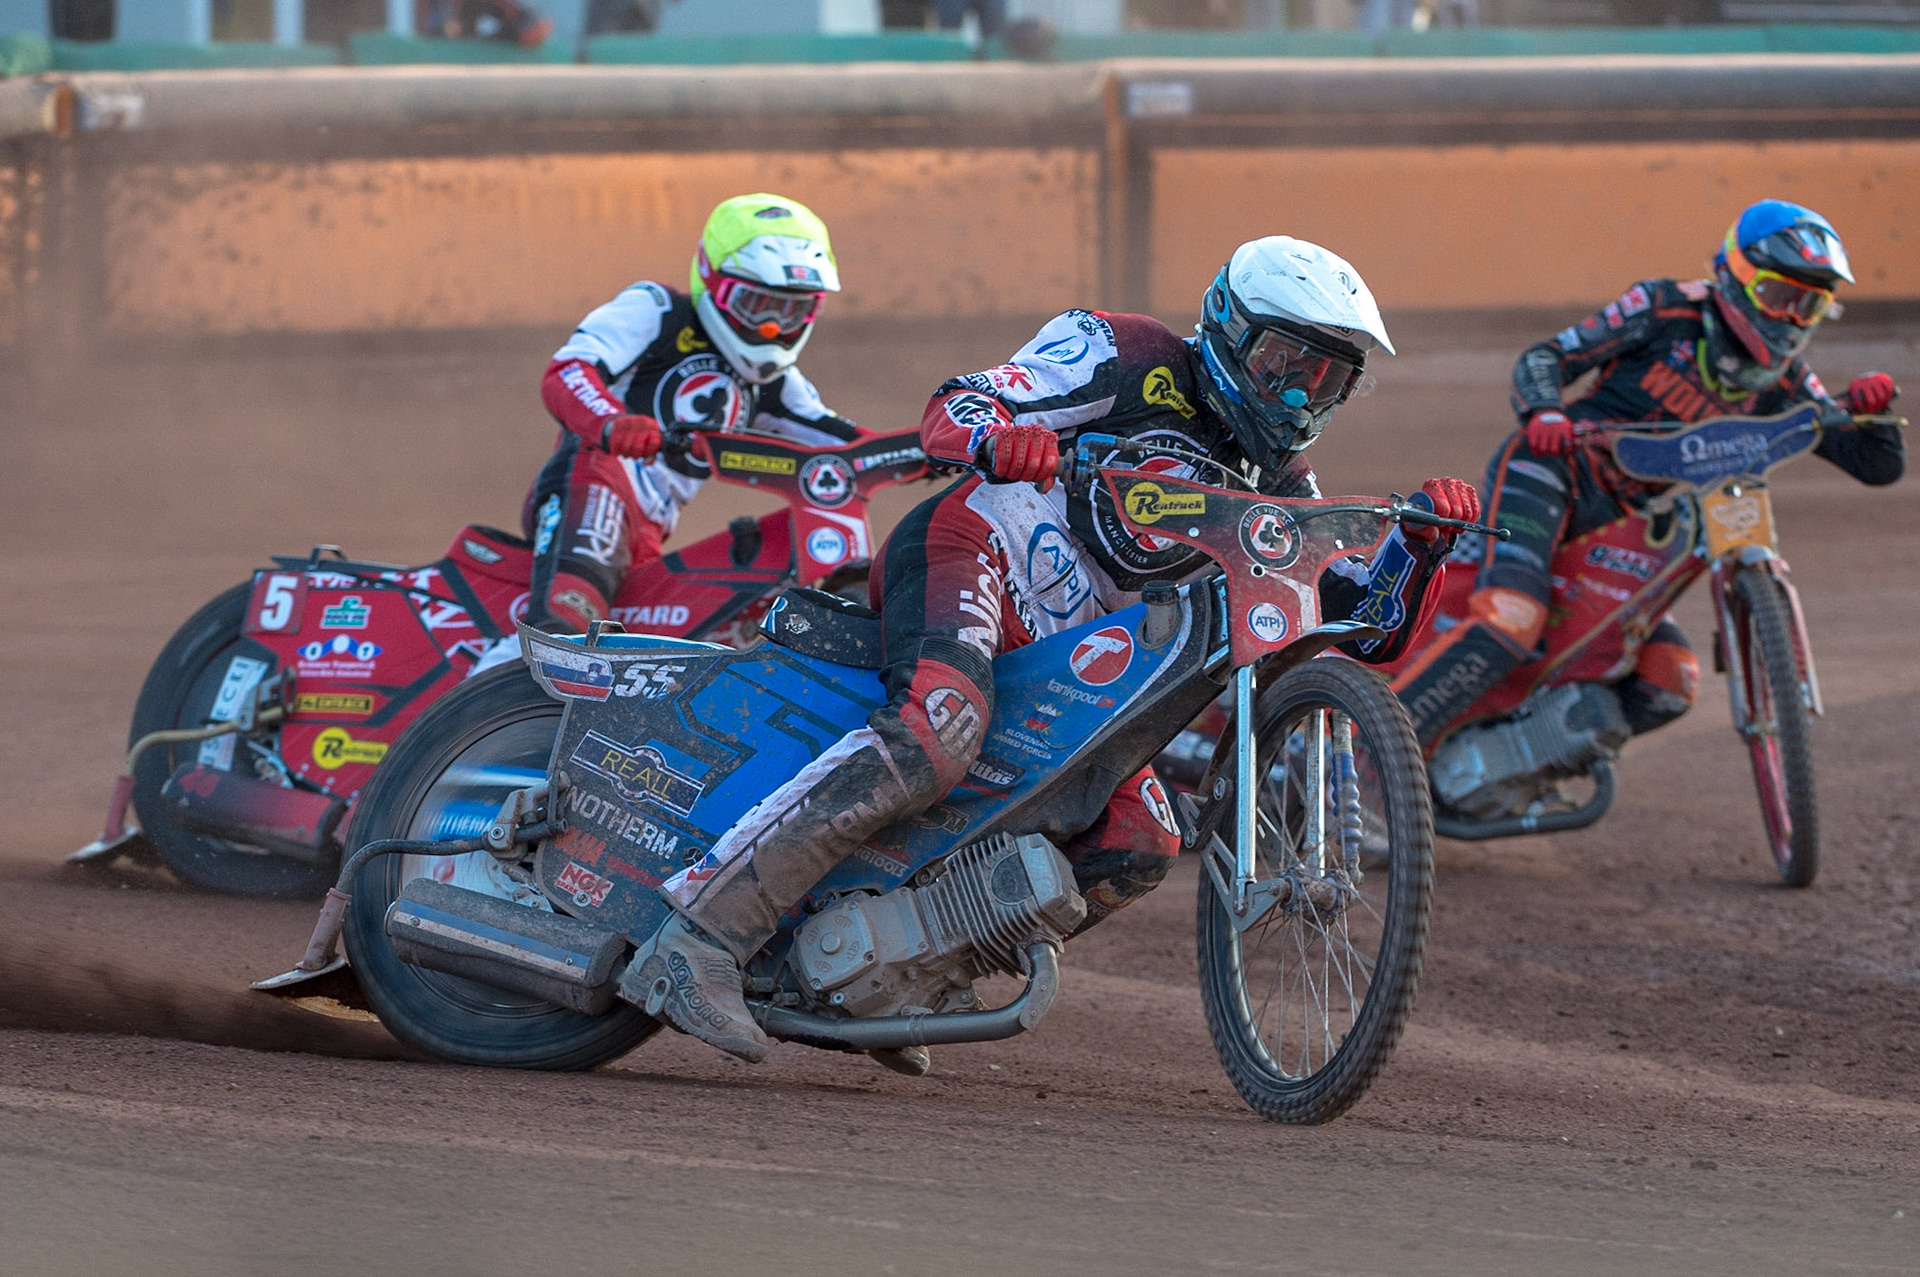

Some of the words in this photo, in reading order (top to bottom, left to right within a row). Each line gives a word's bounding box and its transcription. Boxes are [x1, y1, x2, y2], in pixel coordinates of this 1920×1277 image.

[1131, 491, 1204, 516] Rentruck
[1243, 507, 1262, 529] BELLE
[1280, 513, 1297, 534] ACS
[259, 574, 298, 631] 5
[1254, 615, 1281, 629] ATPI
[614, 662, 687, 700] 55
[1004, 727, 1051, 750] SLOVENIAN
[1021, 743, 1052, 760] FORCES
[600, 749, 673, 800] REALL
[565, 784, 679, 860] NOTHERM
[561, 864, 611, 899] NGK
